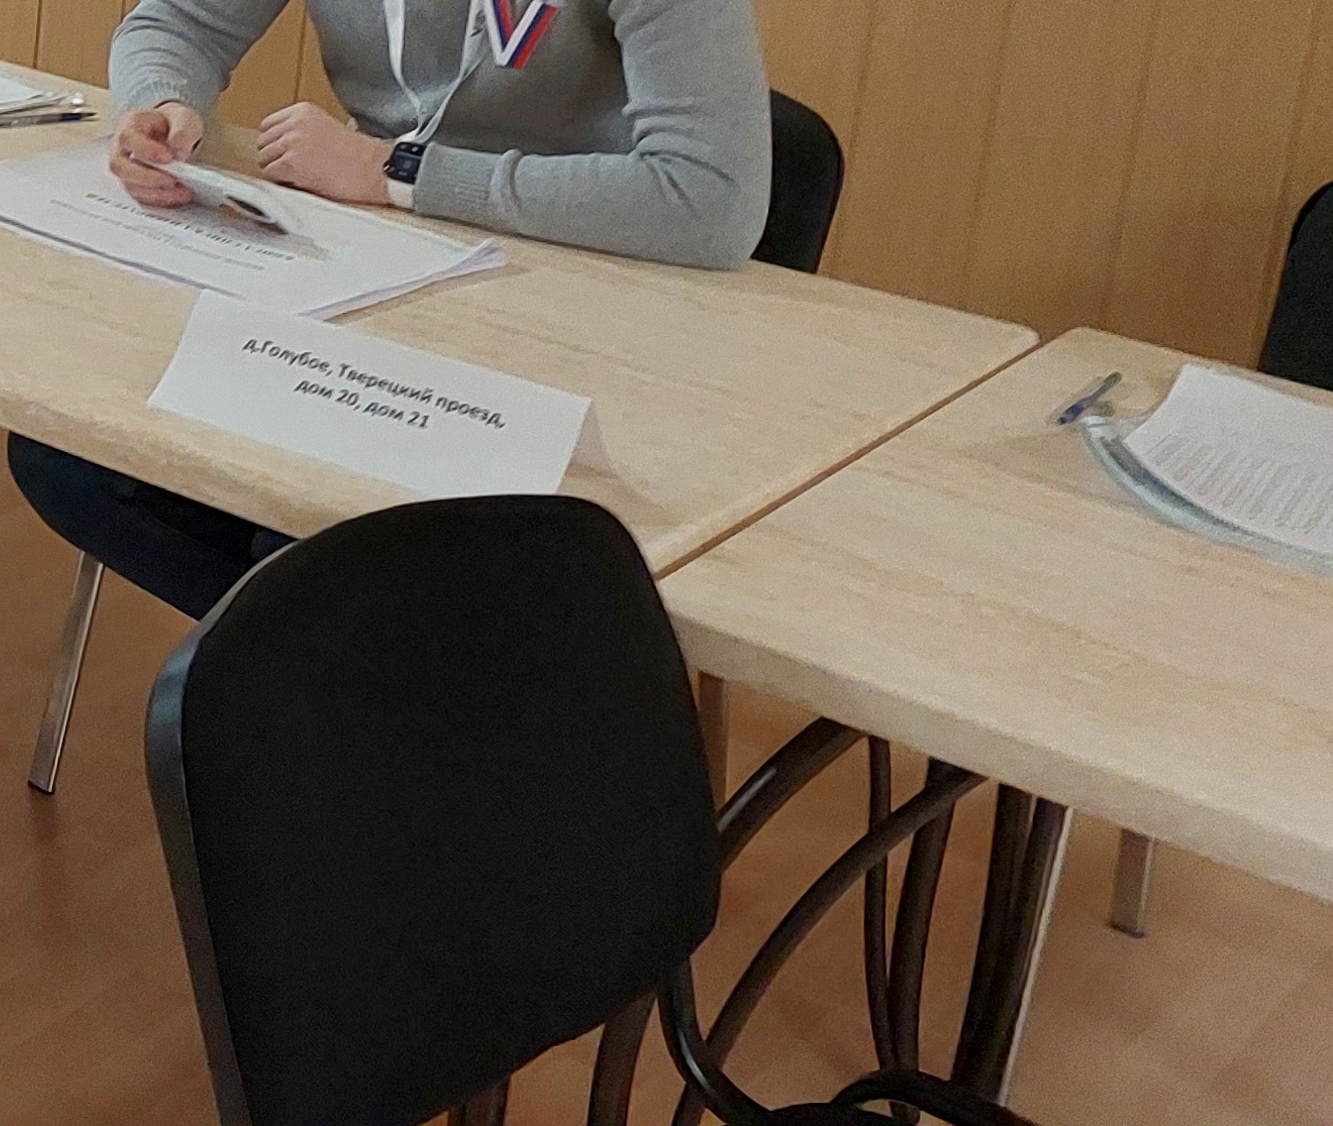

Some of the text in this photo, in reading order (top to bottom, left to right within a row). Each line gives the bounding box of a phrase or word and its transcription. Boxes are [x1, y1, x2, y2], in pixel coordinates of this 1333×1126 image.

[293, 378, 430, 429] дом 20, дом 21
[338, 363, 434, 403] Тверецкий
[435, 396, 506, 429] проезд,
